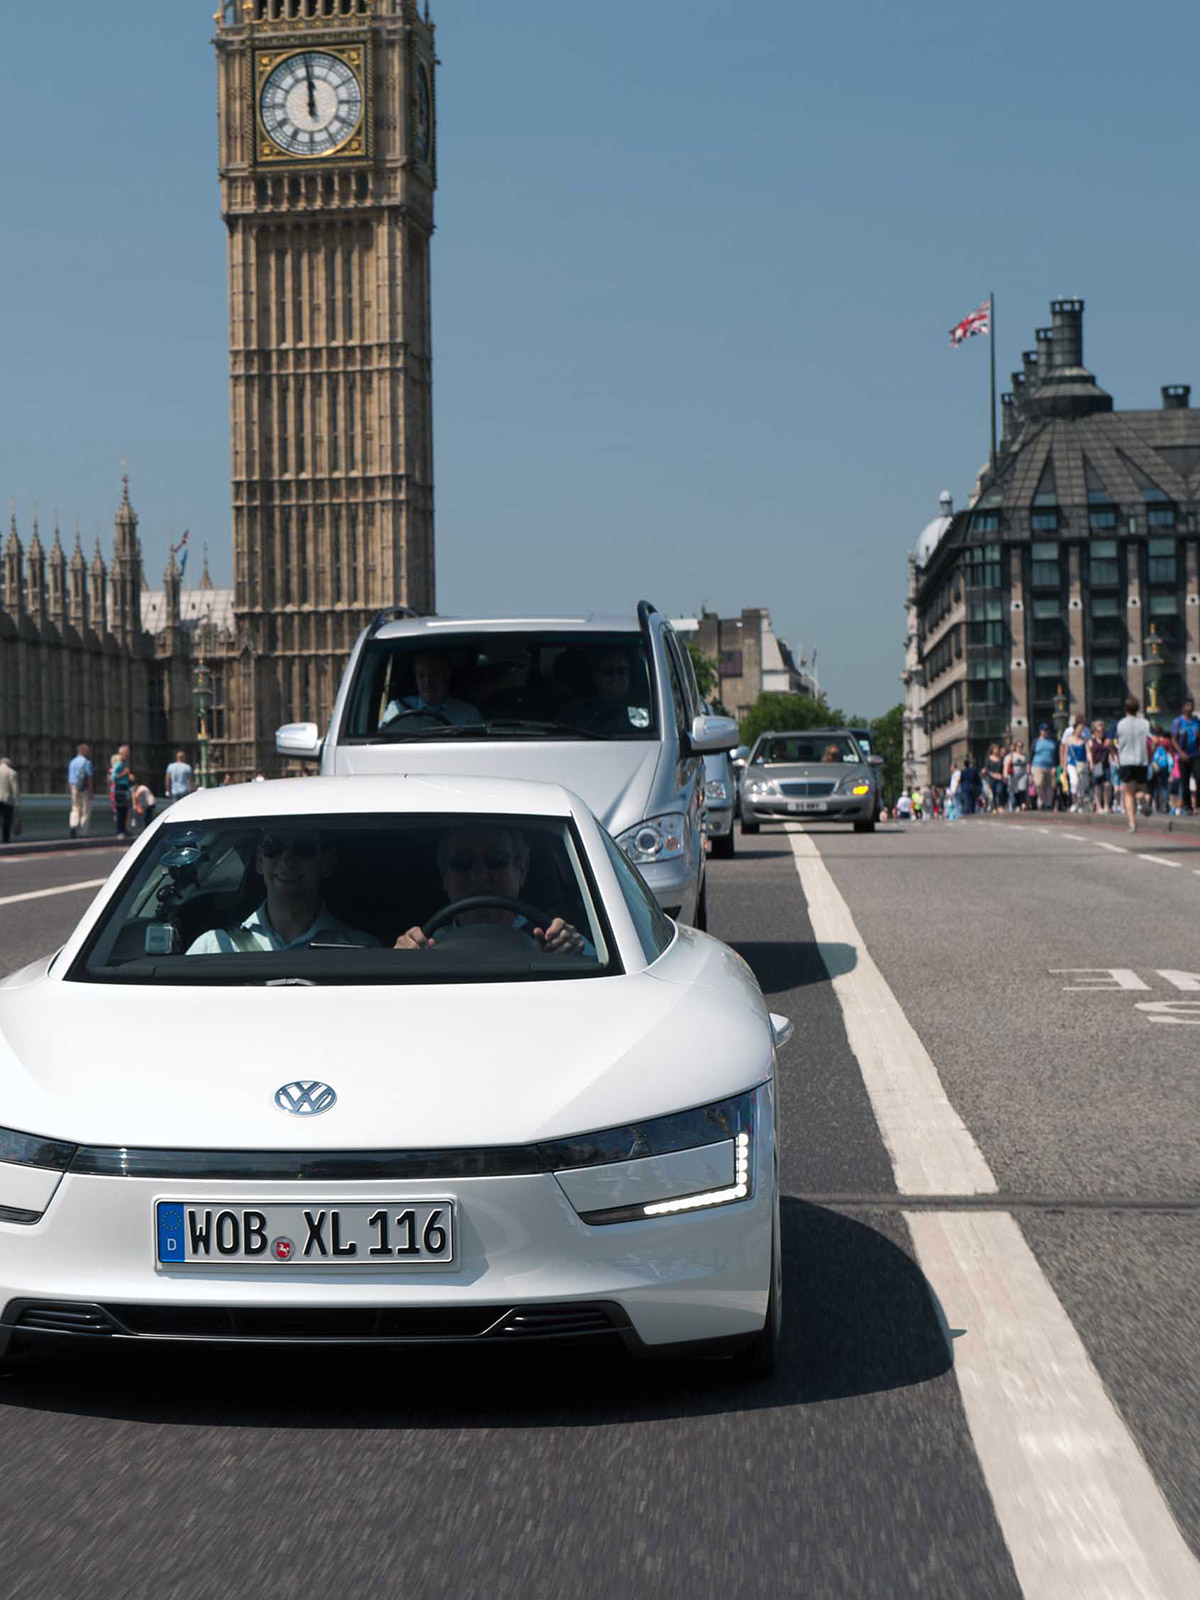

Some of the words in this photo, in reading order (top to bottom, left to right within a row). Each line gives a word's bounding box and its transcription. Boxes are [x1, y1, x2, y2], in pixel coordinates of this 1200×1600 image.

[166, 1238, 177, 1251] D
[187, 1210, 267, 1255] WOB
[303, 1210, 356, 1255] XL
[369, 1210, 447, 1255] 116
